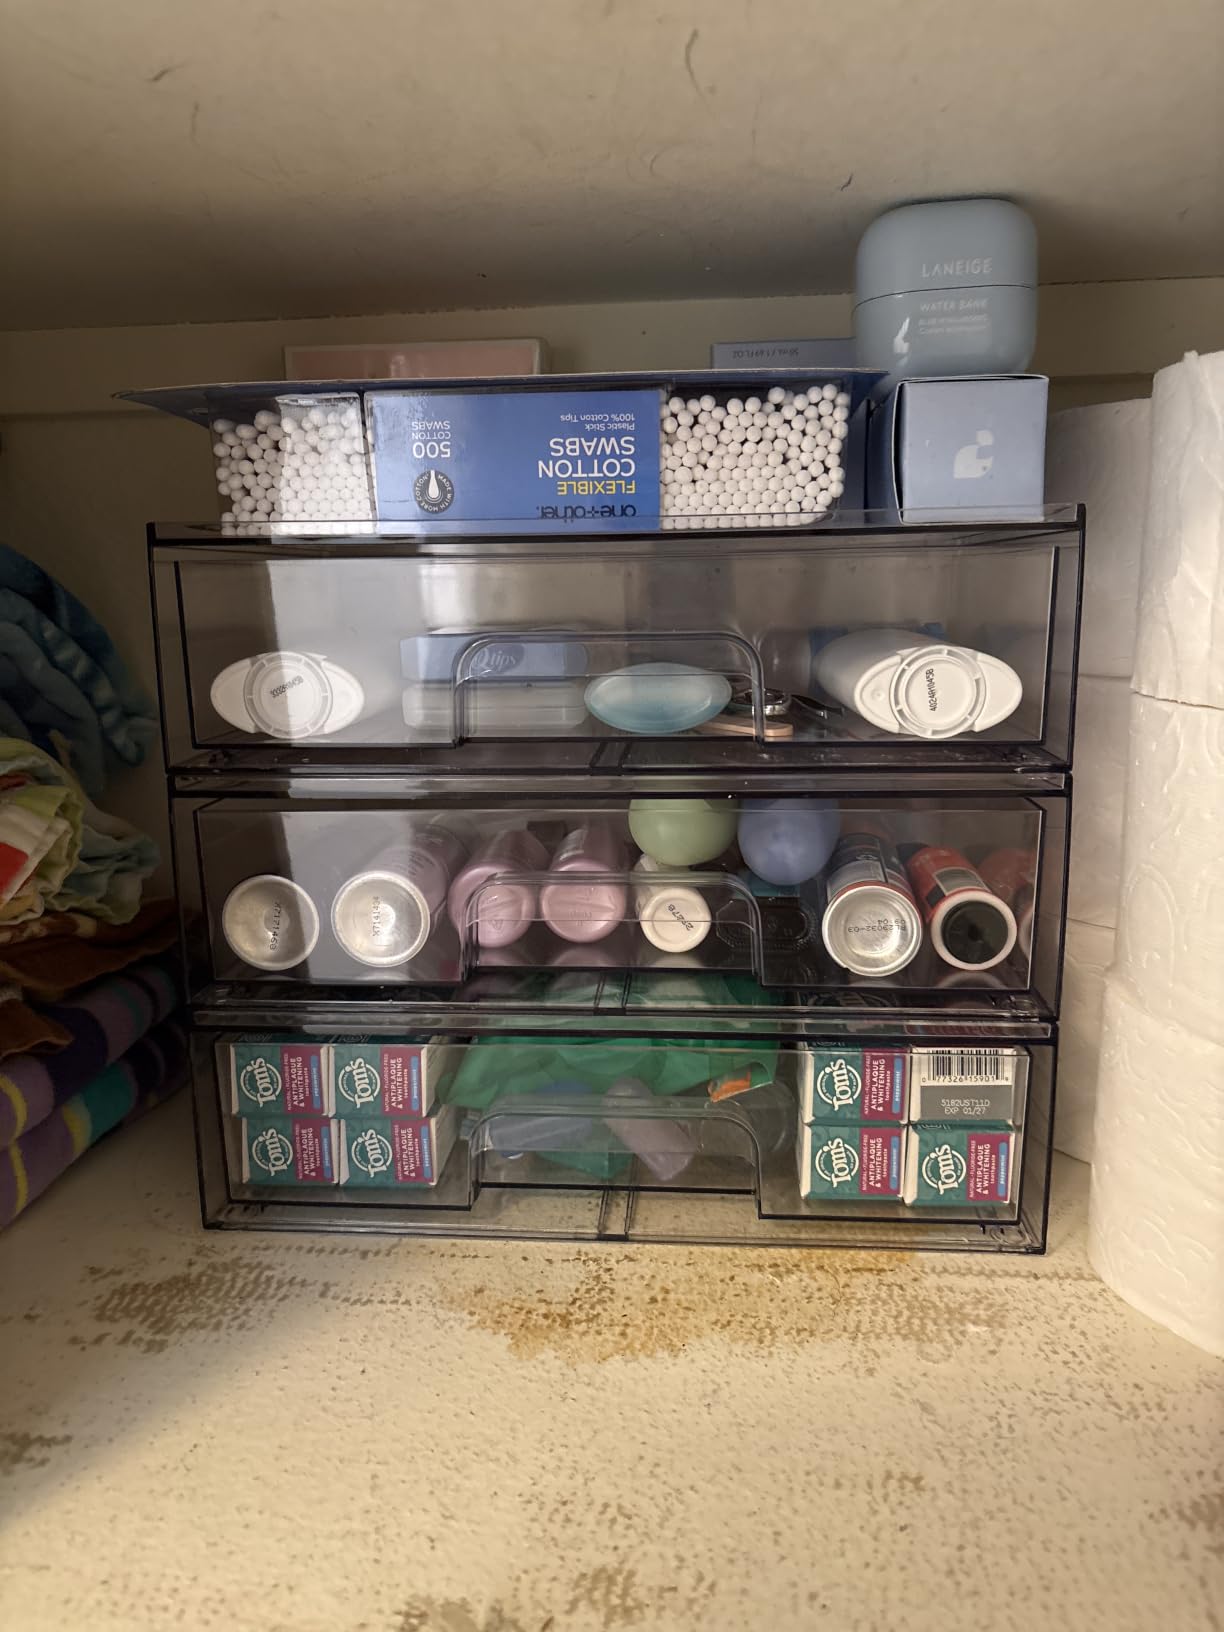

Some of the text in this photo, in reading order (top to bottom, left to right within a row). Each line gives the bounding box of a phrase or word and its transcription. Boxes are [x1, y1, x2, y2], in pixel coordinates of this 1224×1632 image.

[922, 257, 992, 278] LANEIGE
[412, 420, 450, 430] SWABS
[560, 413, 635, 422] 100% Cotton Tips
[585, 422, 635, 431] Plastic Stick
[412, 432, 451, 440] COTTON
[550, 436, 635, 456] SWABS
[412, 442, 450, 458] 500
[538, 458, 636, 478] COTTON
[438, 474, 452, 491] MADE
[557, 480, 636, 495] FLEXIBLE
[420, 502, 439, 512] MORE
[440, 493, 453, 510] WITH
[246, 1058, 276, 1108] Tom's
[290, 1058, 298, 1106] ANTIPLAQUE
[296, 1057, 304, 1100] WHITENING
[344, 1058, 374, 1108] Tom's
[825, 1059, 854, 1111] Tom's
[877, 1059, 885, 1104] WHITENING
[944, 1107, 986, 1116] EXP 01/27
[258, 1128, 288, 1176] Tom's
[301, 1129, 310, 1174] ANTIPLAQUE
[357, 1129, 387, 1178] Tom's
[401, 1129, 409, 1175] ANTIPLAQUE
[823, 1138, 851, 1188] Tom's
[929, 1144, 959, 1195] Tom's
